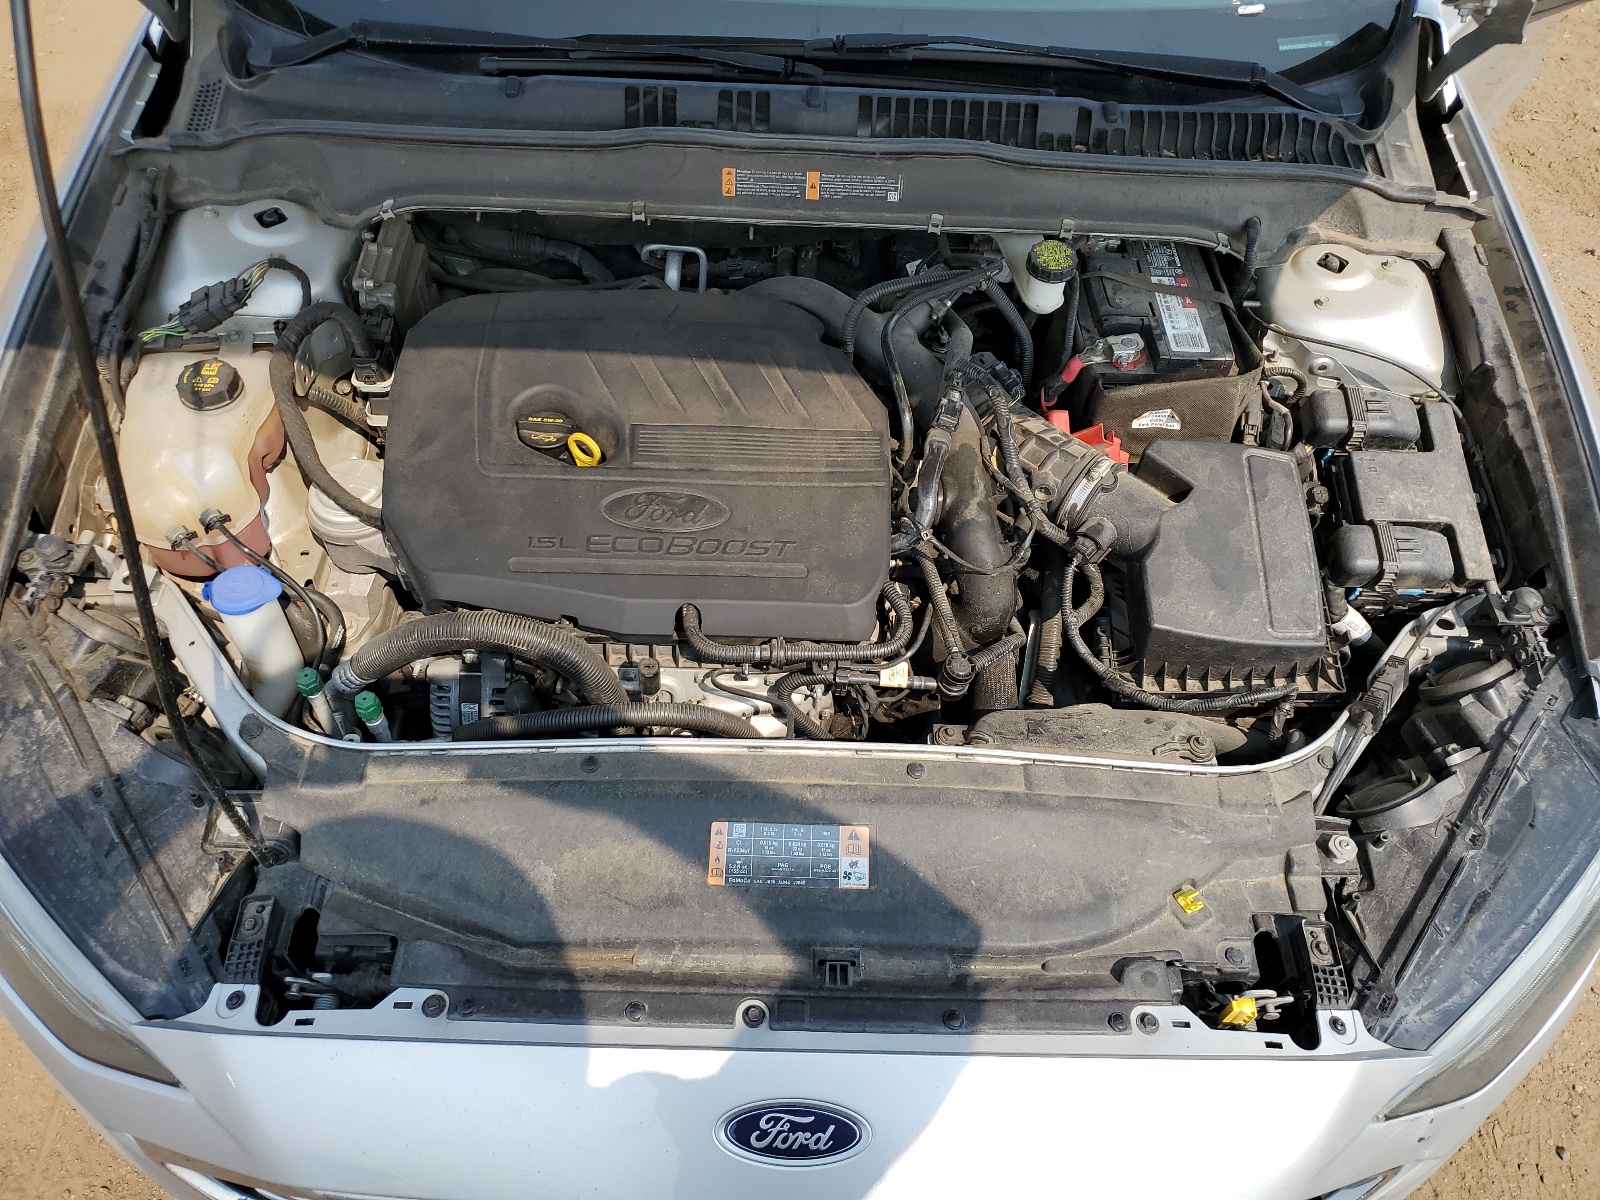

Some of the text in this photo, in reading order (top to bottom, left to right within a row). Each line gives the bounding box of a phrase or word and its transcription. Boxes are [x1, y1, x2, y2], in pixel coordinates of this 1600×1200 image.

[623, 494, 711, 526] Ford
[527, 536, 578, 550] 1.5L
[750, 1112, 836, 1151] Ford
